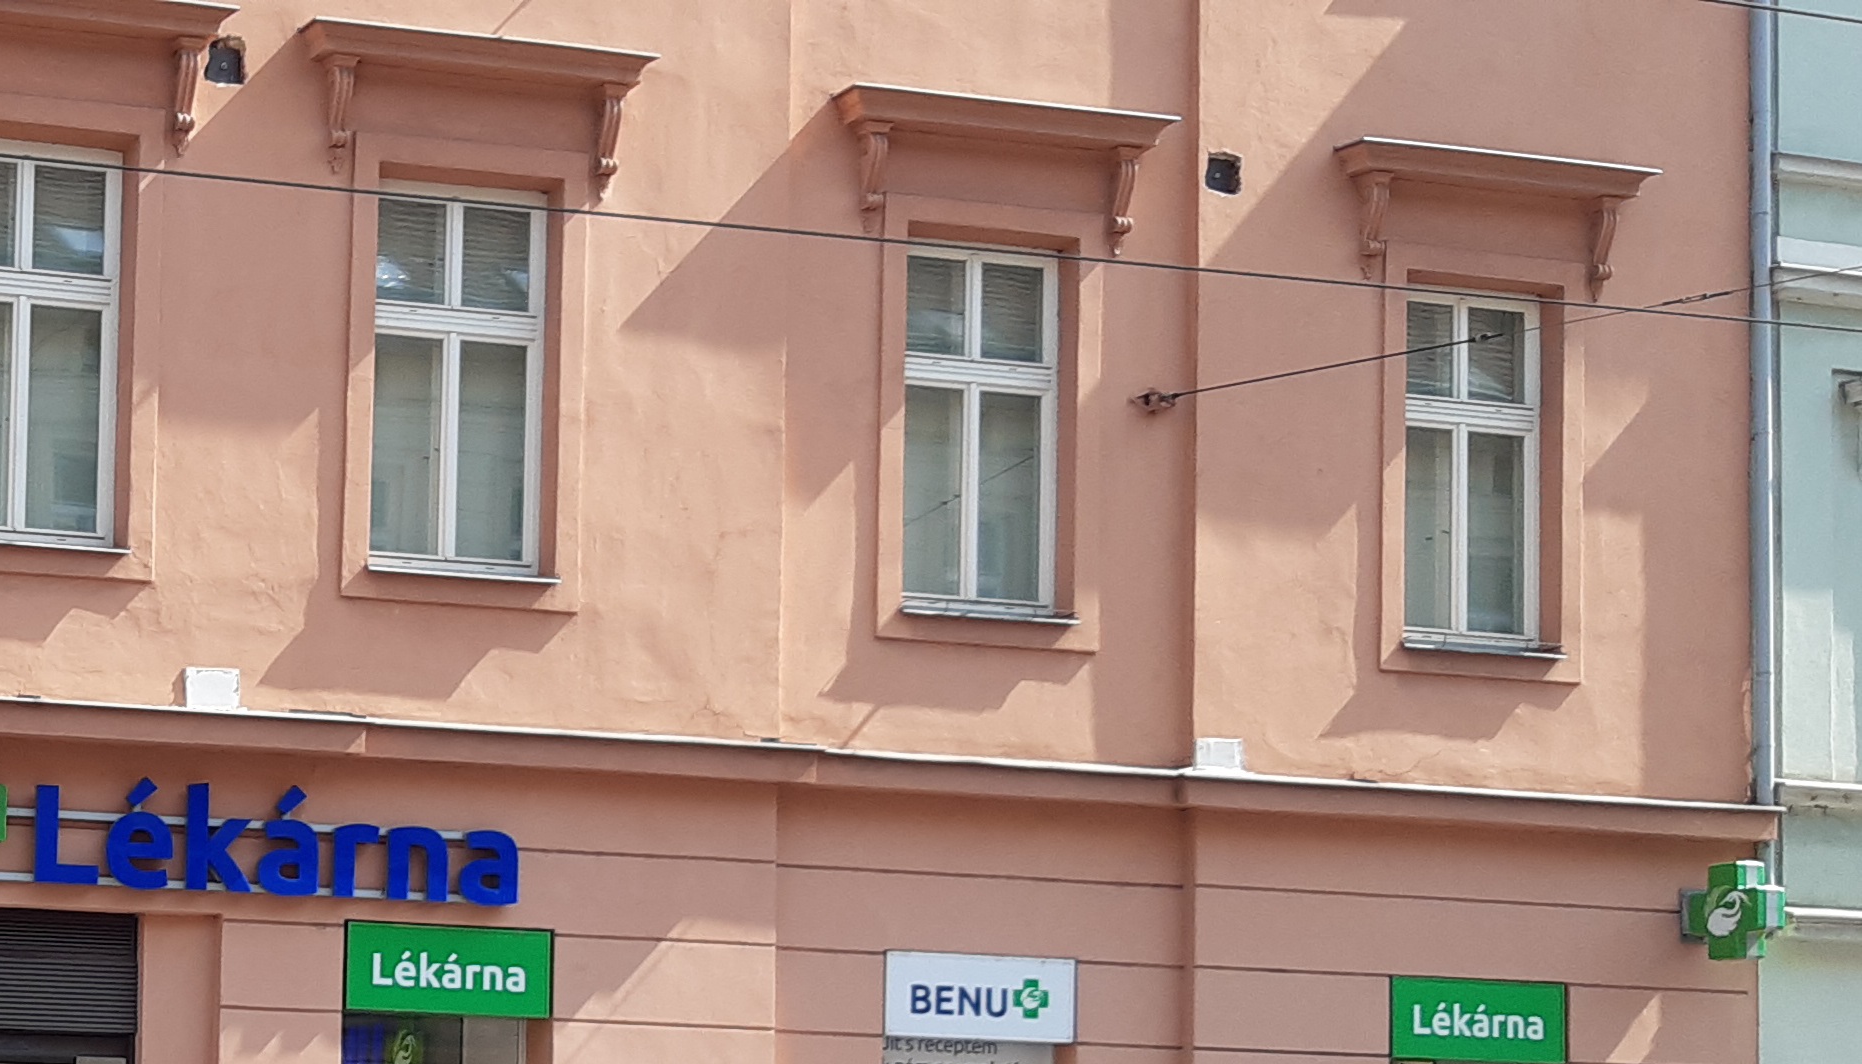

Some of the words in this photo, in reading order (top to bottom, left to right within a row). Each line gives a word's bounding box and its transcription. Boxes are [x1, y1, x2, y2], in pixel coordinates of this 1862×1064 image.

[34, 777, 519, 907] Lékárna
[372, 951, 526, 994] Lékárna
[910, 984, 1008, 1018] BENU
[1413, 1002, 1545, 1041] Lékárna
[918, 1038, 998, 1055] receptem
